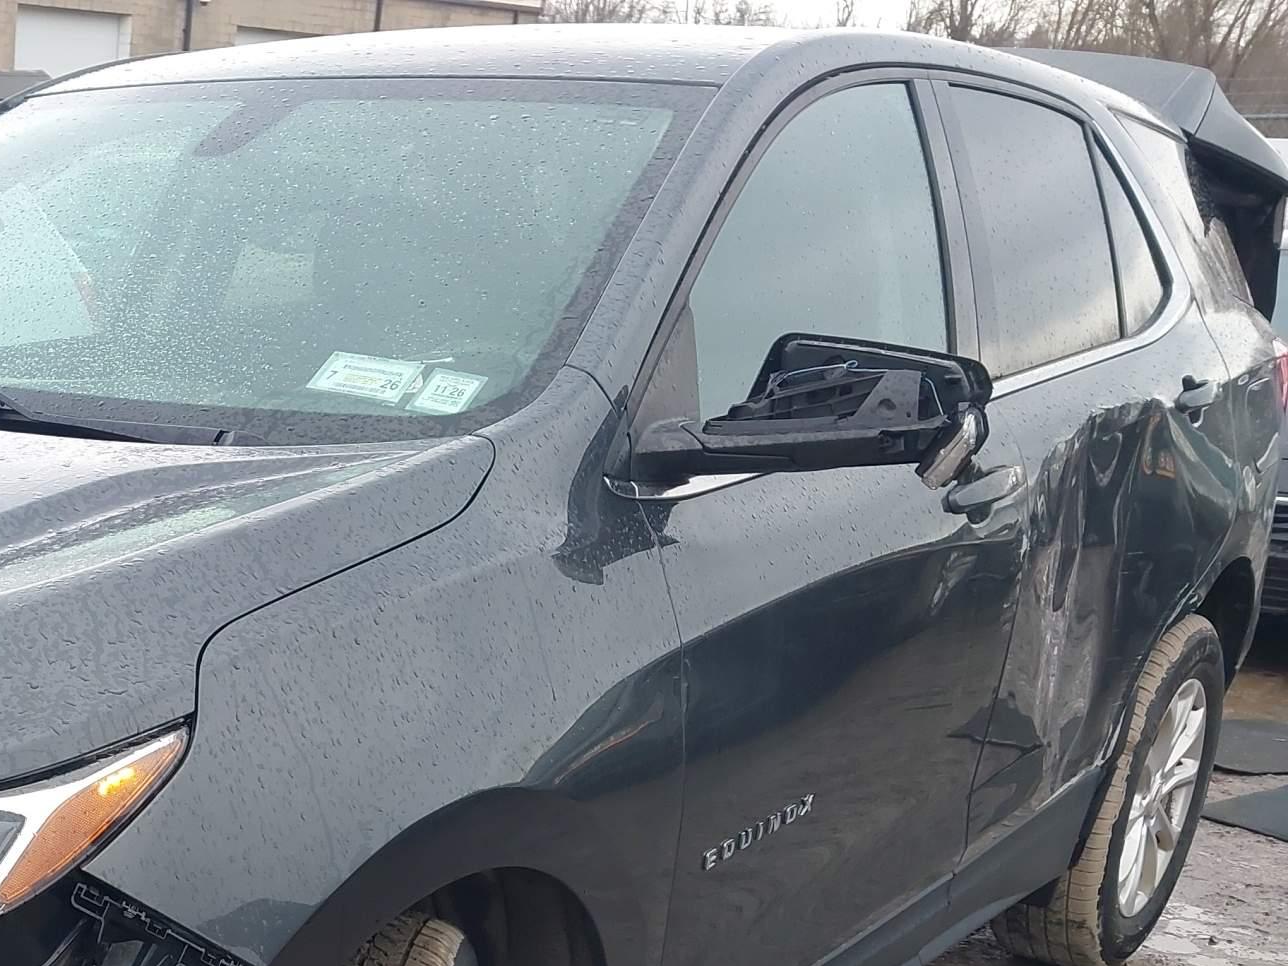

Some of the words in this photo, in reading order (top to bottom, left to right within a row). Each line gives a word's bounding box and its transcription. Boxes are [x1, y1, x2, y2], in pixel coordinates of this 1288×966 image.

[380, 379, 402, 391] 26
[434, 384, 448, 394] 11
[450, 386, 467, 397] 26
[702, 792, 816, 872] EQUINOX
